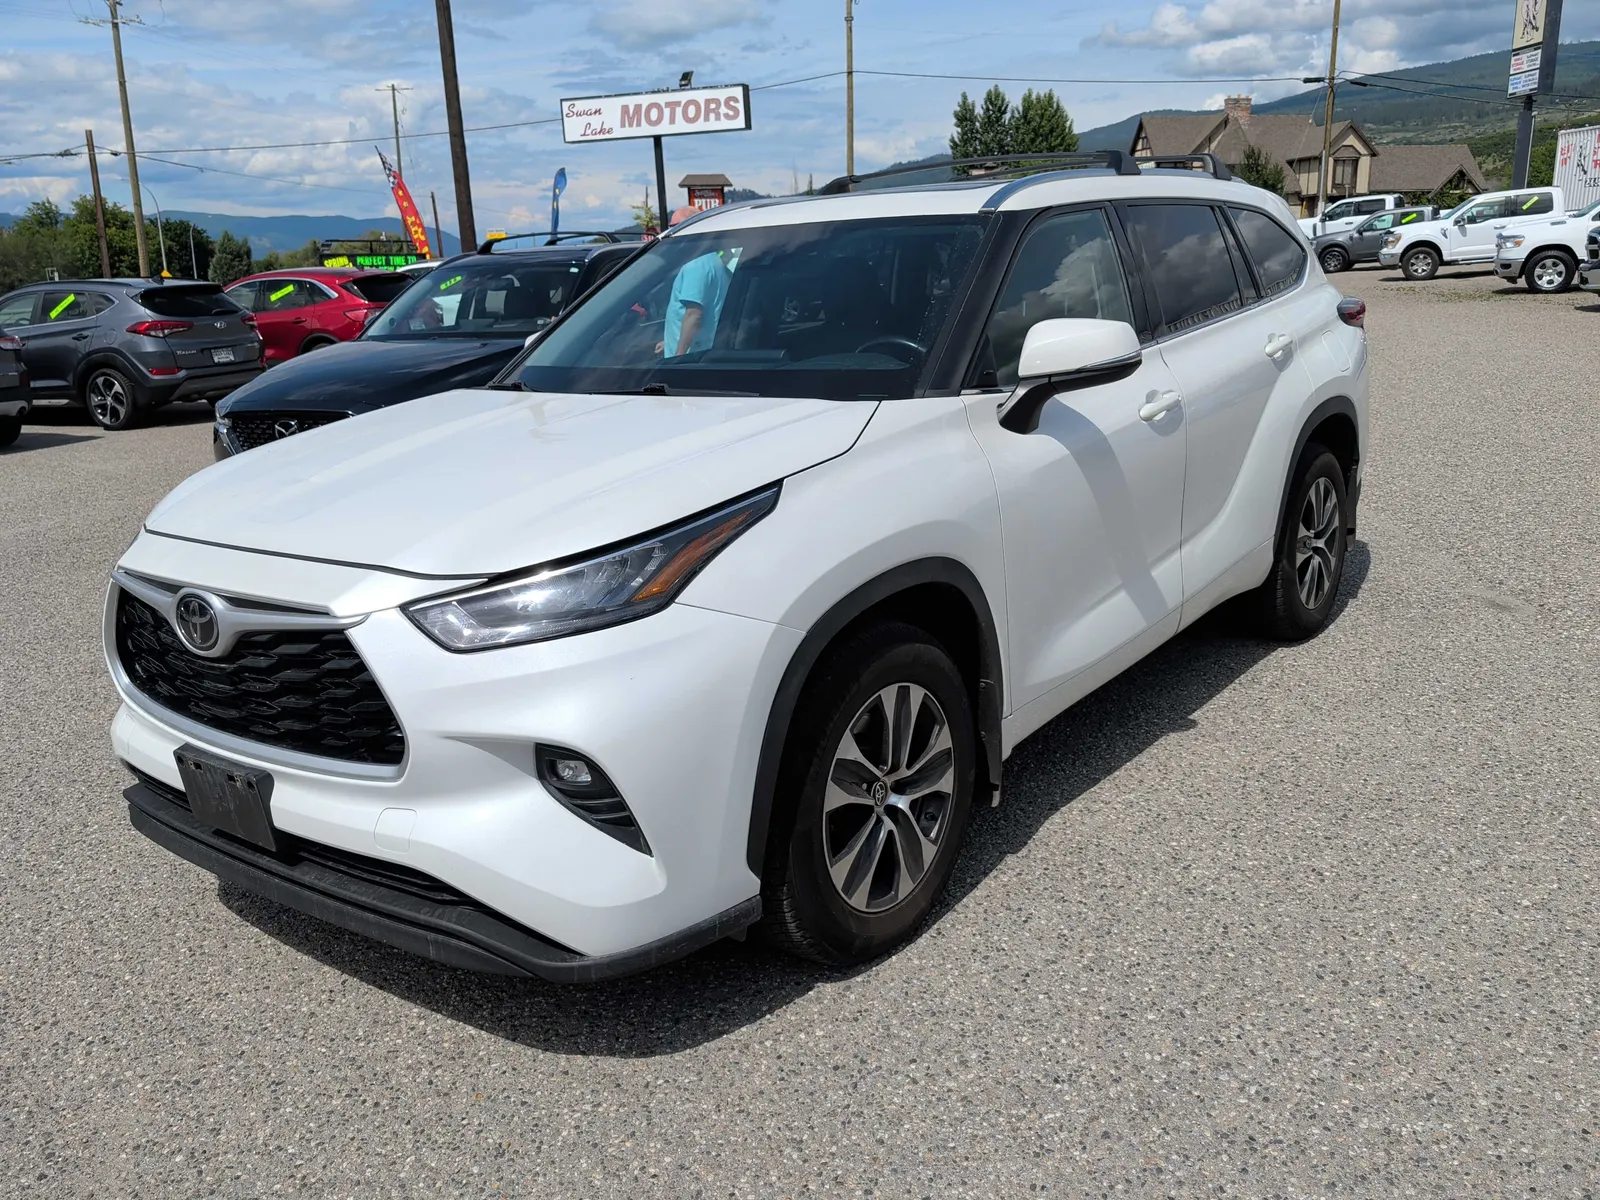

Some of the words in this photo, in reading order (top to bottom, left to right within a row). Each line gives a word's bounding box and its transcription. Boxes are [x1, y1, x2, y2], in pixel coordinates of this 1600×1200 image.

[565, 103, 602, 118] Swan
[620, 96, 740, 129] MOTORS
[580, 121, 614, 137] Lake
[356, 255, 386, 266] PERFECT
[389, 255, 406, 266] TIME
